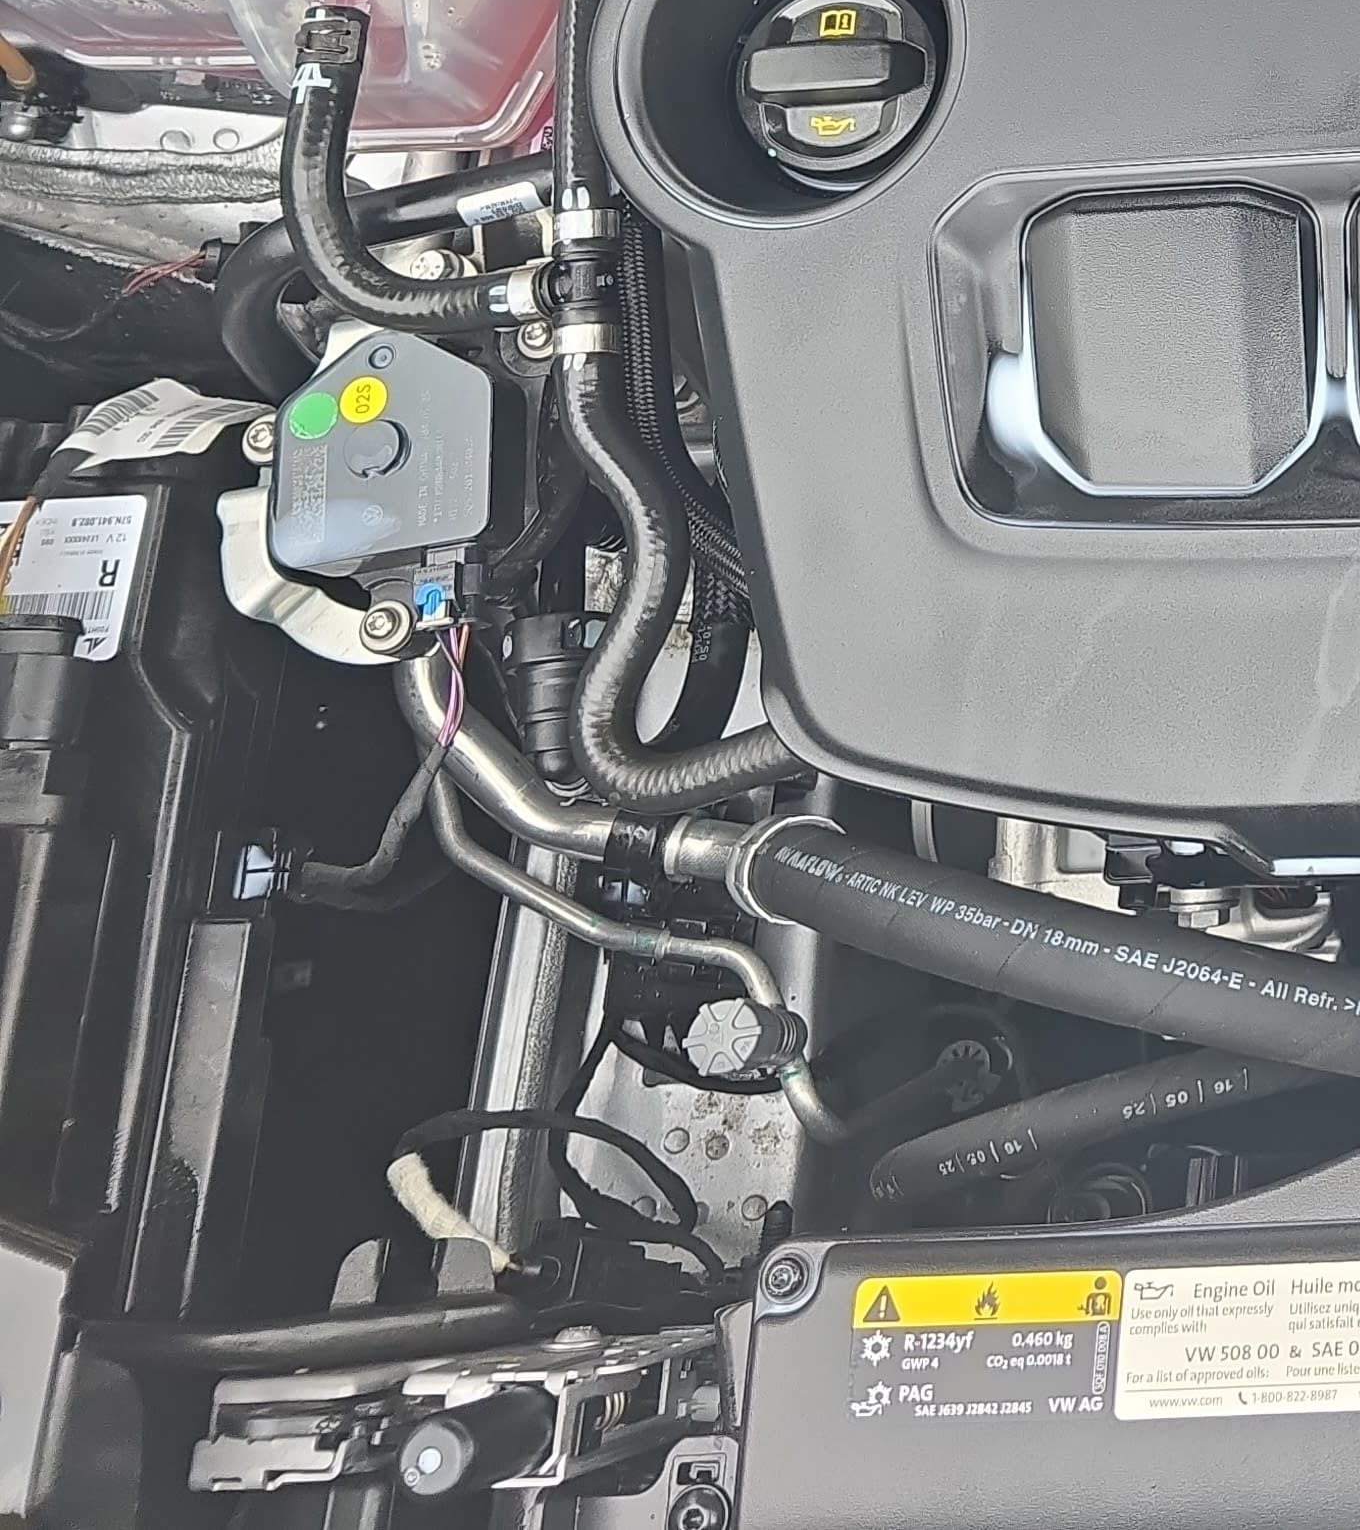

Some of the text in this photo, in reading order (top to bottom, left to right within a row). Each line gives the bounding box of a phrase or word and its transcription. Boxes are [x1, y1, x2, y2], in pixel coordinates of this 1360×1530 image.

[355, 383, 371, 414] 02S
[99, 560, 121, 587] R
[879, 883, 900, 900] NK
[900, 887, 928, 908] LEV
[930, 895, 956, 916] WP
[955, 905, 1001, 930] 35bar
[1010, 920, 1039, 940] DN
[1114, 946, 1160, 970] SAE
[1162, 957, 1244, 990] J2064-E
[1261, 980, 1288, 1000] All
[1294, 986, 1338, 1011] Refr.
[1193, 1278, 1275, 1303] Engine Oil
[1290, 1277, 1333, 1295] Huile
[1131, 1302, 1274, 1322] Use only oil that expressly
[1289, 1301, 1331, 1315] Utilisez
[1129, 1320, 1207, 1337] complies with
[1288, 1317, 1307, 1334] qui
[1309, 1315, 1354, 1330] satisfait
[903, 1330, 974, 1353] R-1234yf
[1011, 1330, 1073, 1350] 0.460 kg
[1184, 1345, 1216, 1363] VW
[1220, 1344, 1251, 1361] 508
[1257, 1343, 1280, 1360] 00
[1289, 1345, 1302, 1359] &
[1311, 1340, 1343, 1358] SAE
[901, 1357, 939, 1370] GWP 4
[1009, 1356, 1024, 1371] eq
[1026, 1353, 1064, 1366] 0.0018
[1065, 1353, 1071, 1365] t
[1285, 1365, 1311, 1377] Pour
[1313, 1365, 1335, 1376] une
[1337, 1362, 1360, 1375] liste
[1126, 1366, 1269, 1384] For a list of approved oils:
[898, 1383, 933, 1403] PAG
[1149, 1396, 1223, 1408] www.vw.com
[914, 1401, 1032, 1417] SAE J639 J2842 J2845
[1048, 1396, 1103, 1413] VW AG
